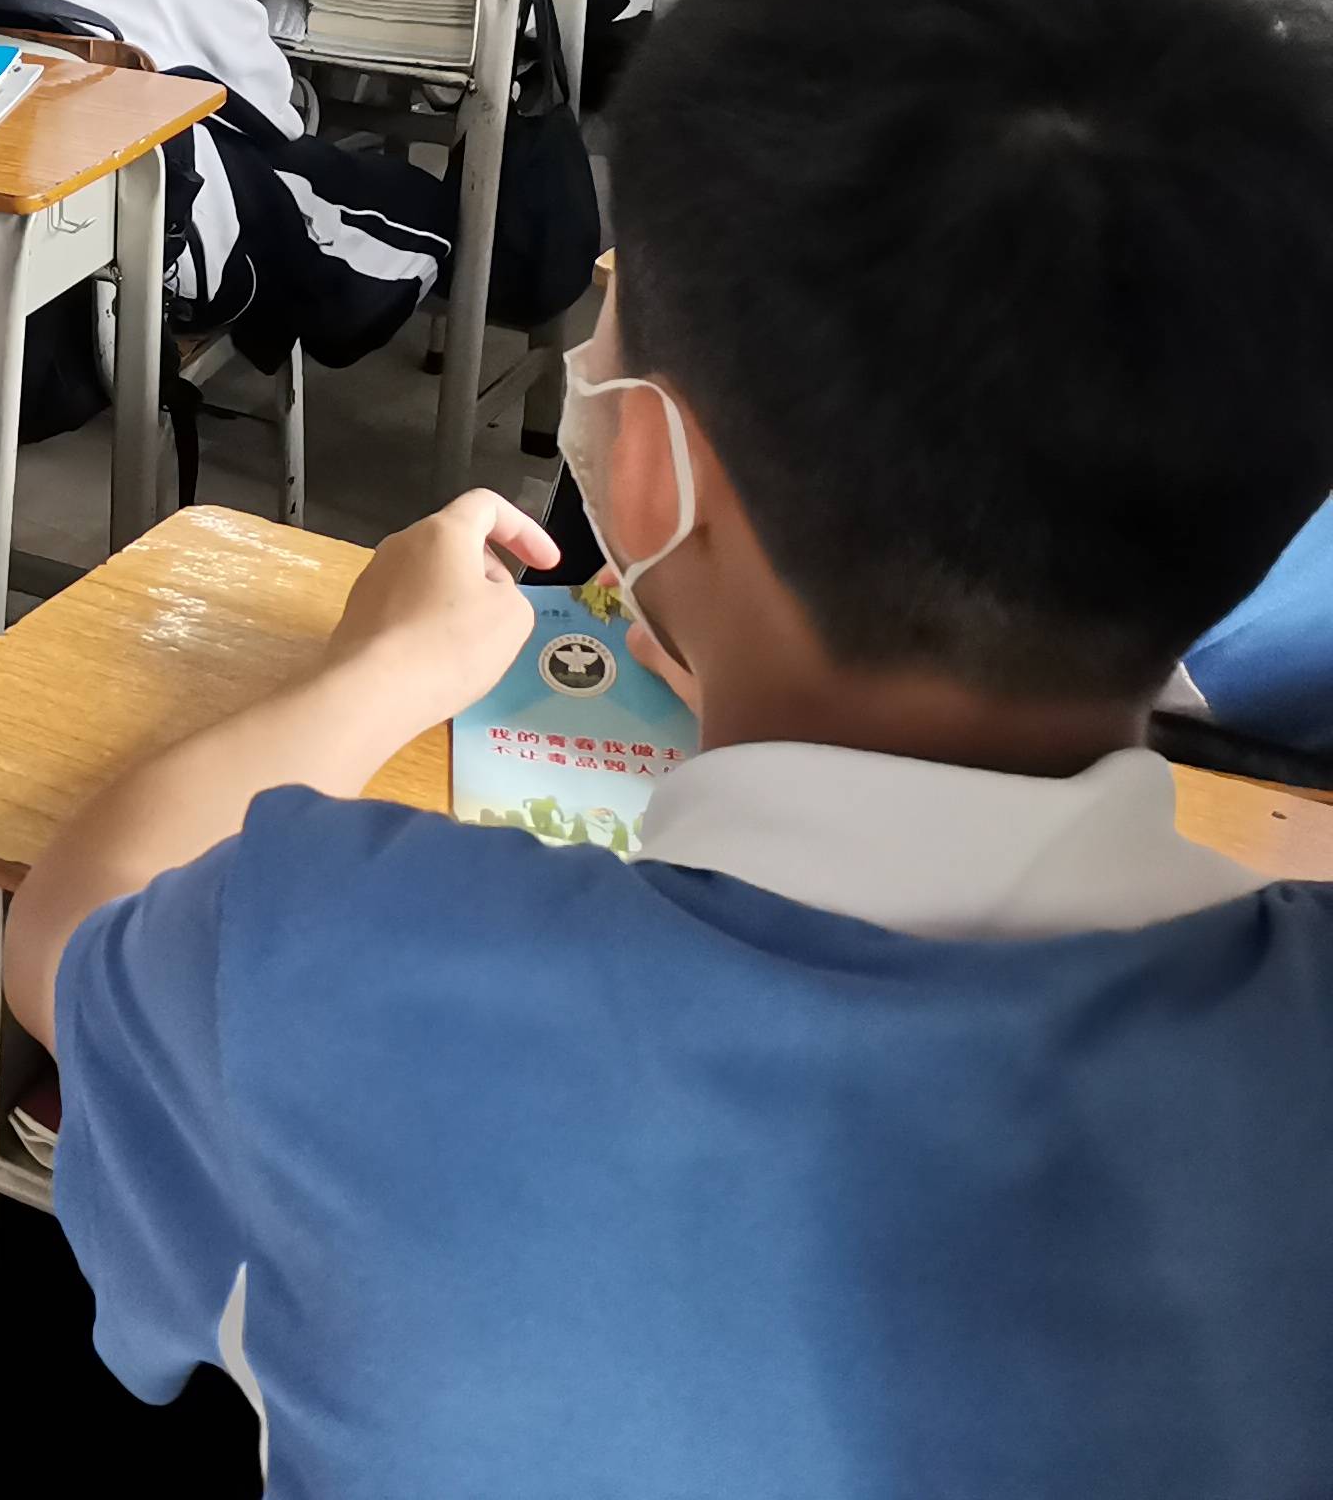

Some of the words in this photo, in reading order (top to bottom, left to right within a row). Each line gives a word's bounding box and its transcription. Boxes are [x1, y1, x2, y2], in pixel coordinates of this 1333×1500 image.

[487, 726, 684, 761] 我的青春我做主
